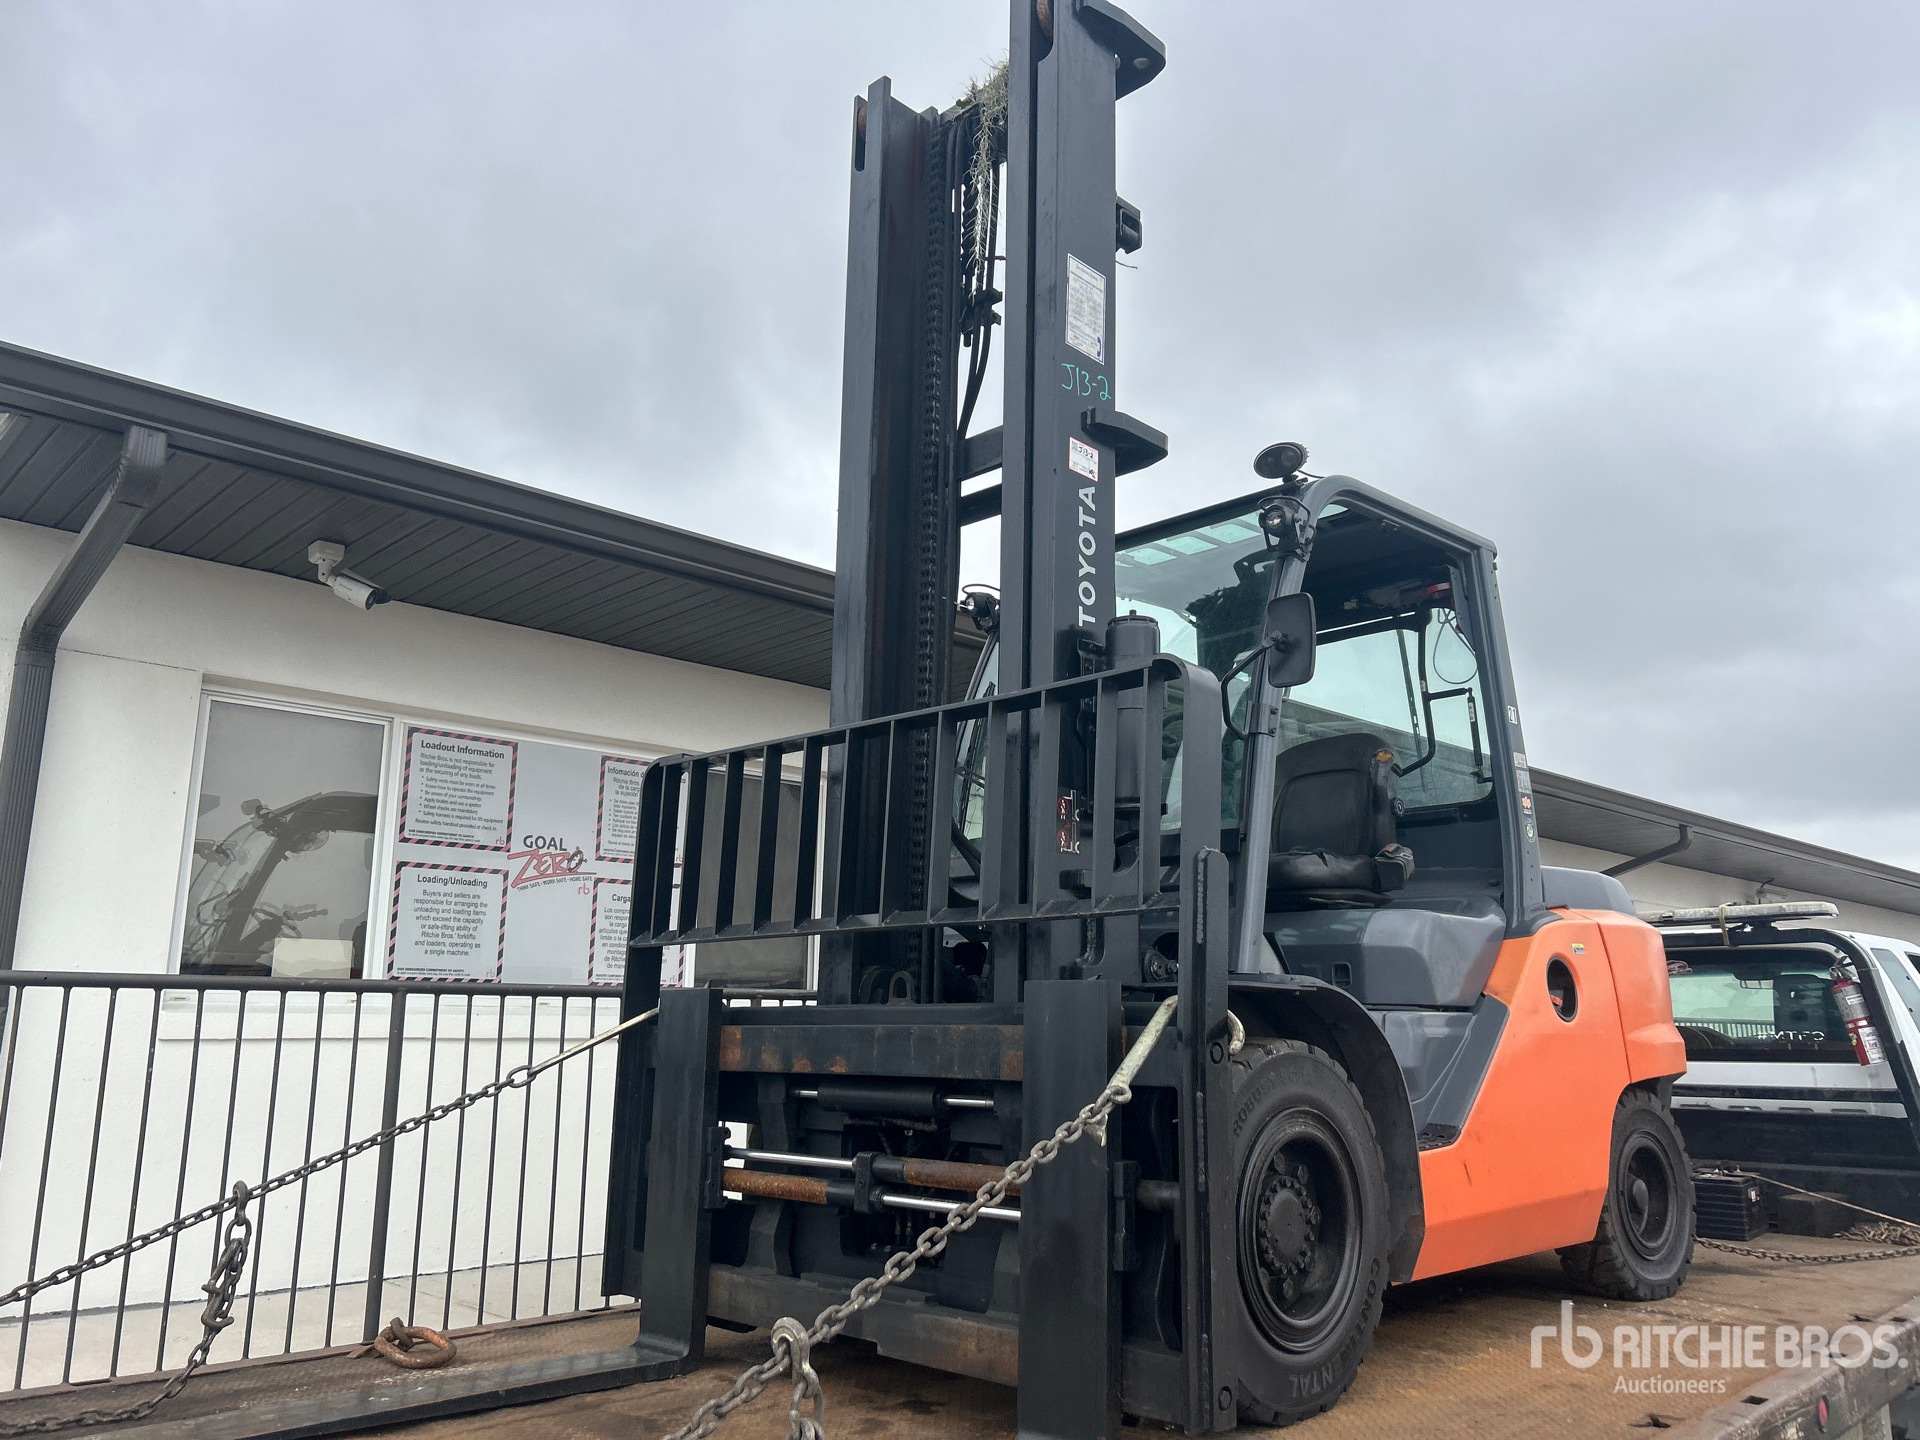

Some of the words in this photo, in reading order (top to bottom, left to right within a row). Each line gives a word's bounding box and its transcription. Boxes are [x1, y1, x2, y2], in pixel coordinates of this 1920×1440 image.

[1061, 363, 1111, 400] J13-2
[1078, 486, 1096, 626] TOYOTA
[421, 740, 456, 753] Loadout
[457, 745, 504, 759] Information
[523, 835, 567, 851] GOAL
[507, 846, 592, 888] ZERO
[417, 874, 488, 889] Loading/Unloading
[578, 882, 590, 895] rb
[454, 901, 478, 909] arranging
[612, 894, 630, 903] Carga
[414, 906, 440, 914] unloading
[428, 923, 454, 932] safe-lifting
[456, 924, 471, 932] ability
[462, 917, 483, 925] capacity
[426, 940, 447, 948] loaders,
[448, 941, 473, 949] operating
[1289, 1257, 1380, 1398] CONTINNTAL
